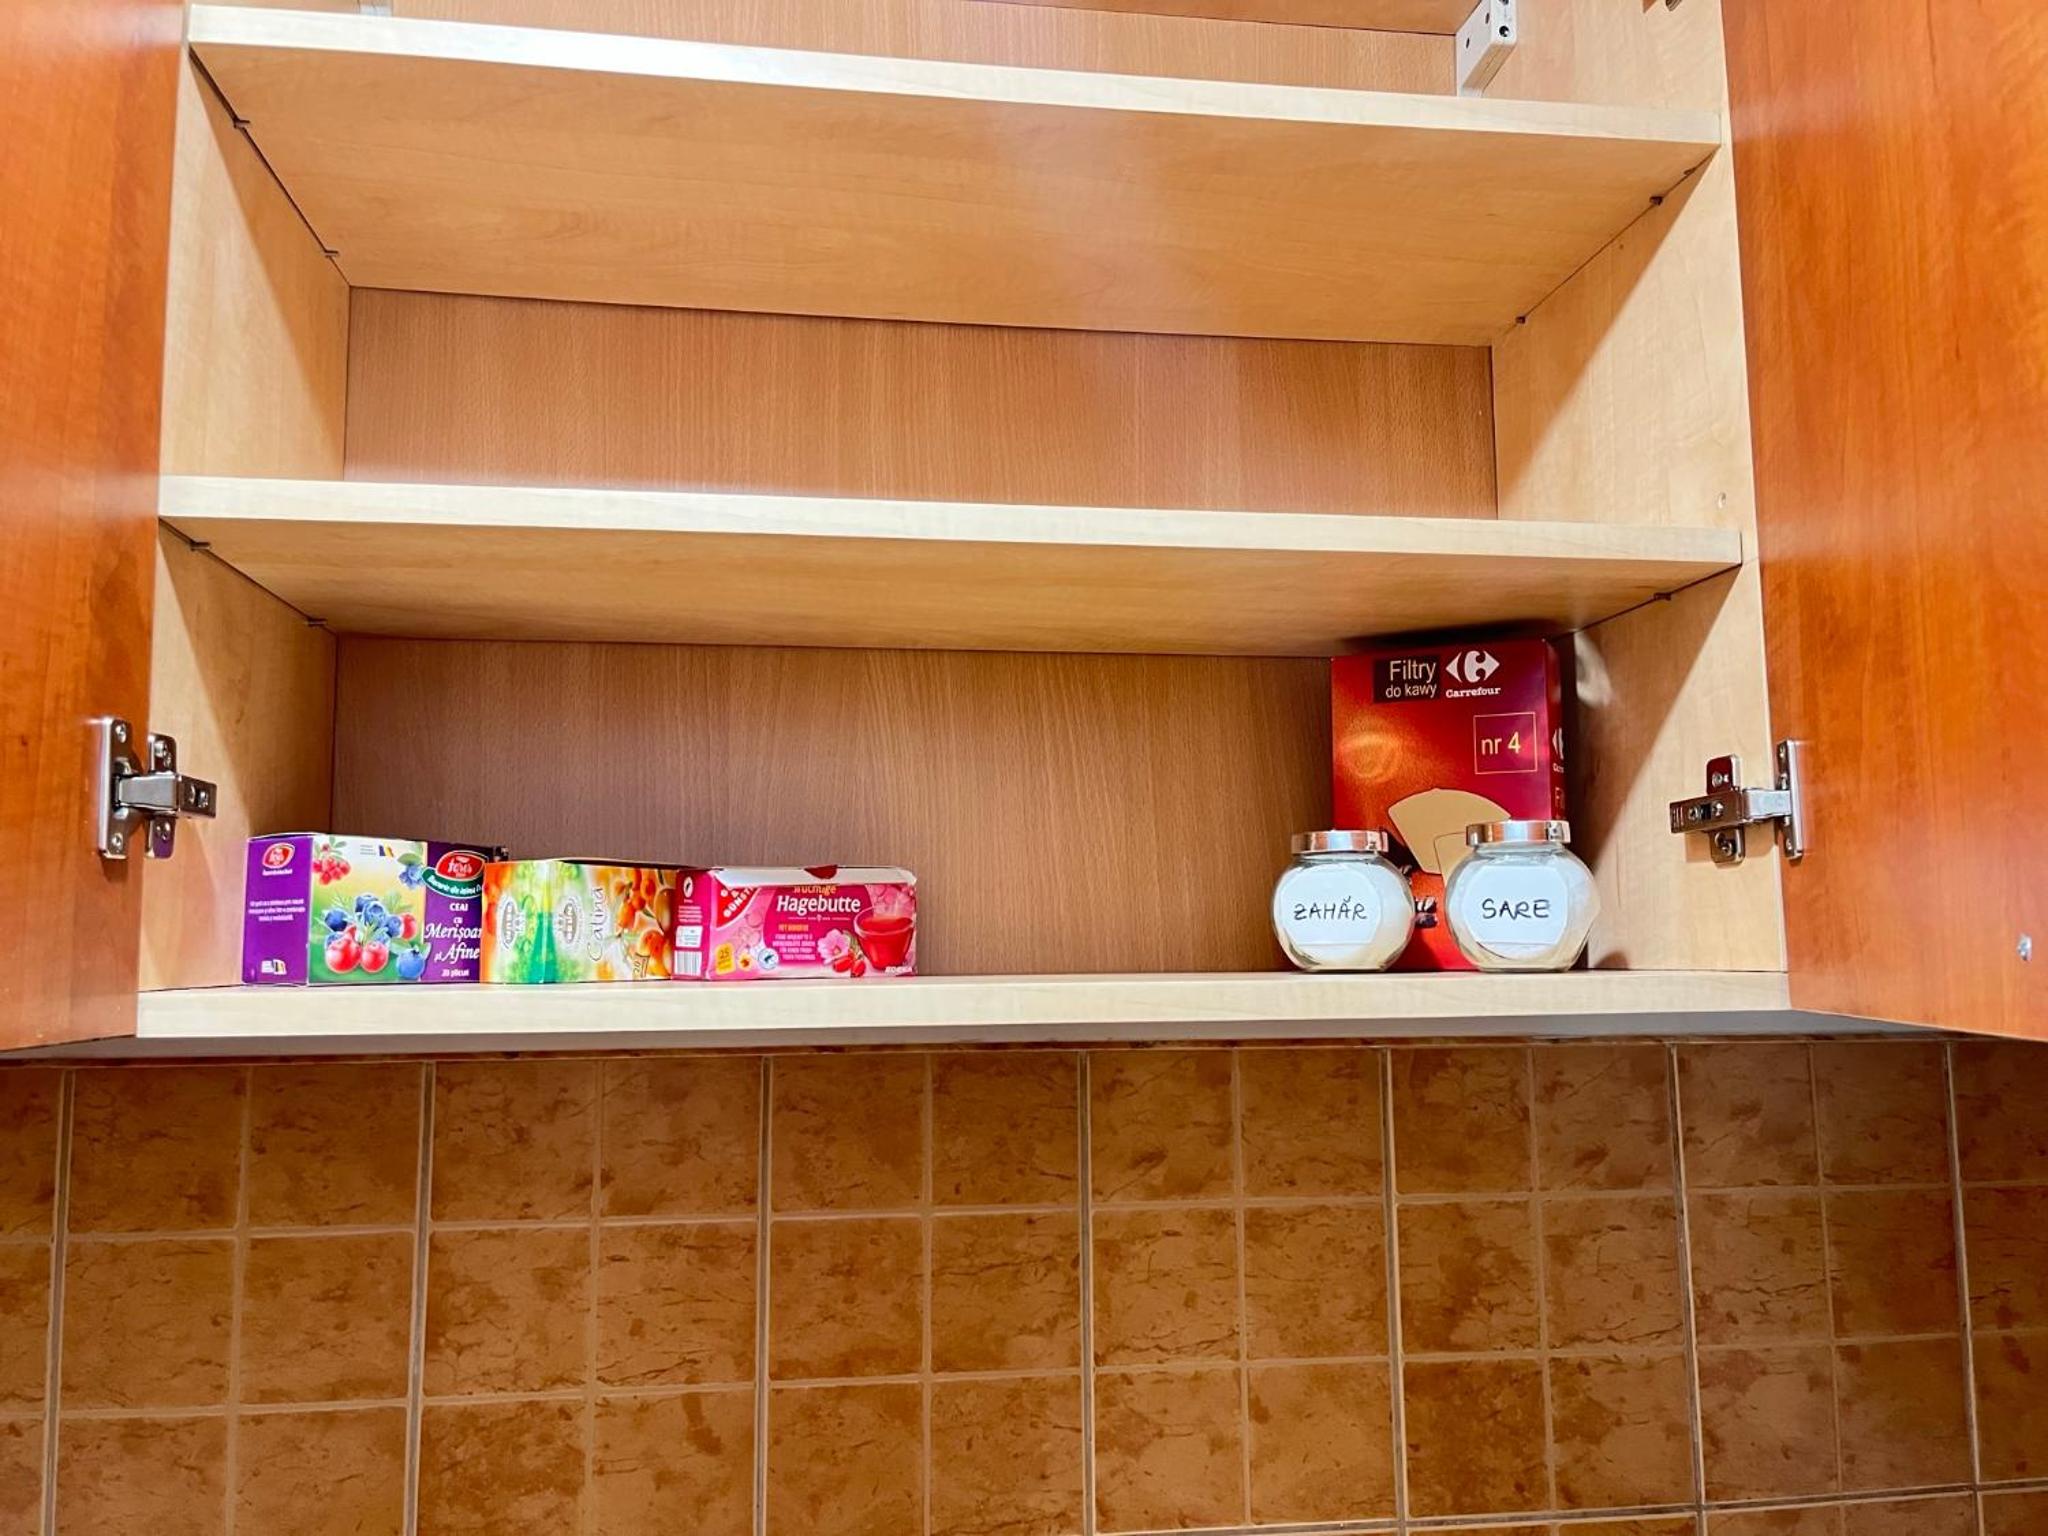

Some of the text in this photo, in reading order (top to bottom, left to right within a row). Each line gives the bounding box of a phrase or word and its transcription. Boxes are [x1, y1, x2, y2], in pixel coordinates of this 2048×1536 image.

[1389, 660, 1436, 684] Filtry
[1386, 683, 1437, 698] do kawy
[1446, 686, 1502, 698] Carrefour
[1481, 731, 1521, 755] nr 4
[776, 894, 861, 916] Hagebutte
[1293, 896, 1368, 920] ZAHĂR
[1482, 898, 1551, 920] SARE
[424, 922, 482, 942] Merișoar
[441, 942, 480, 965] Afine
